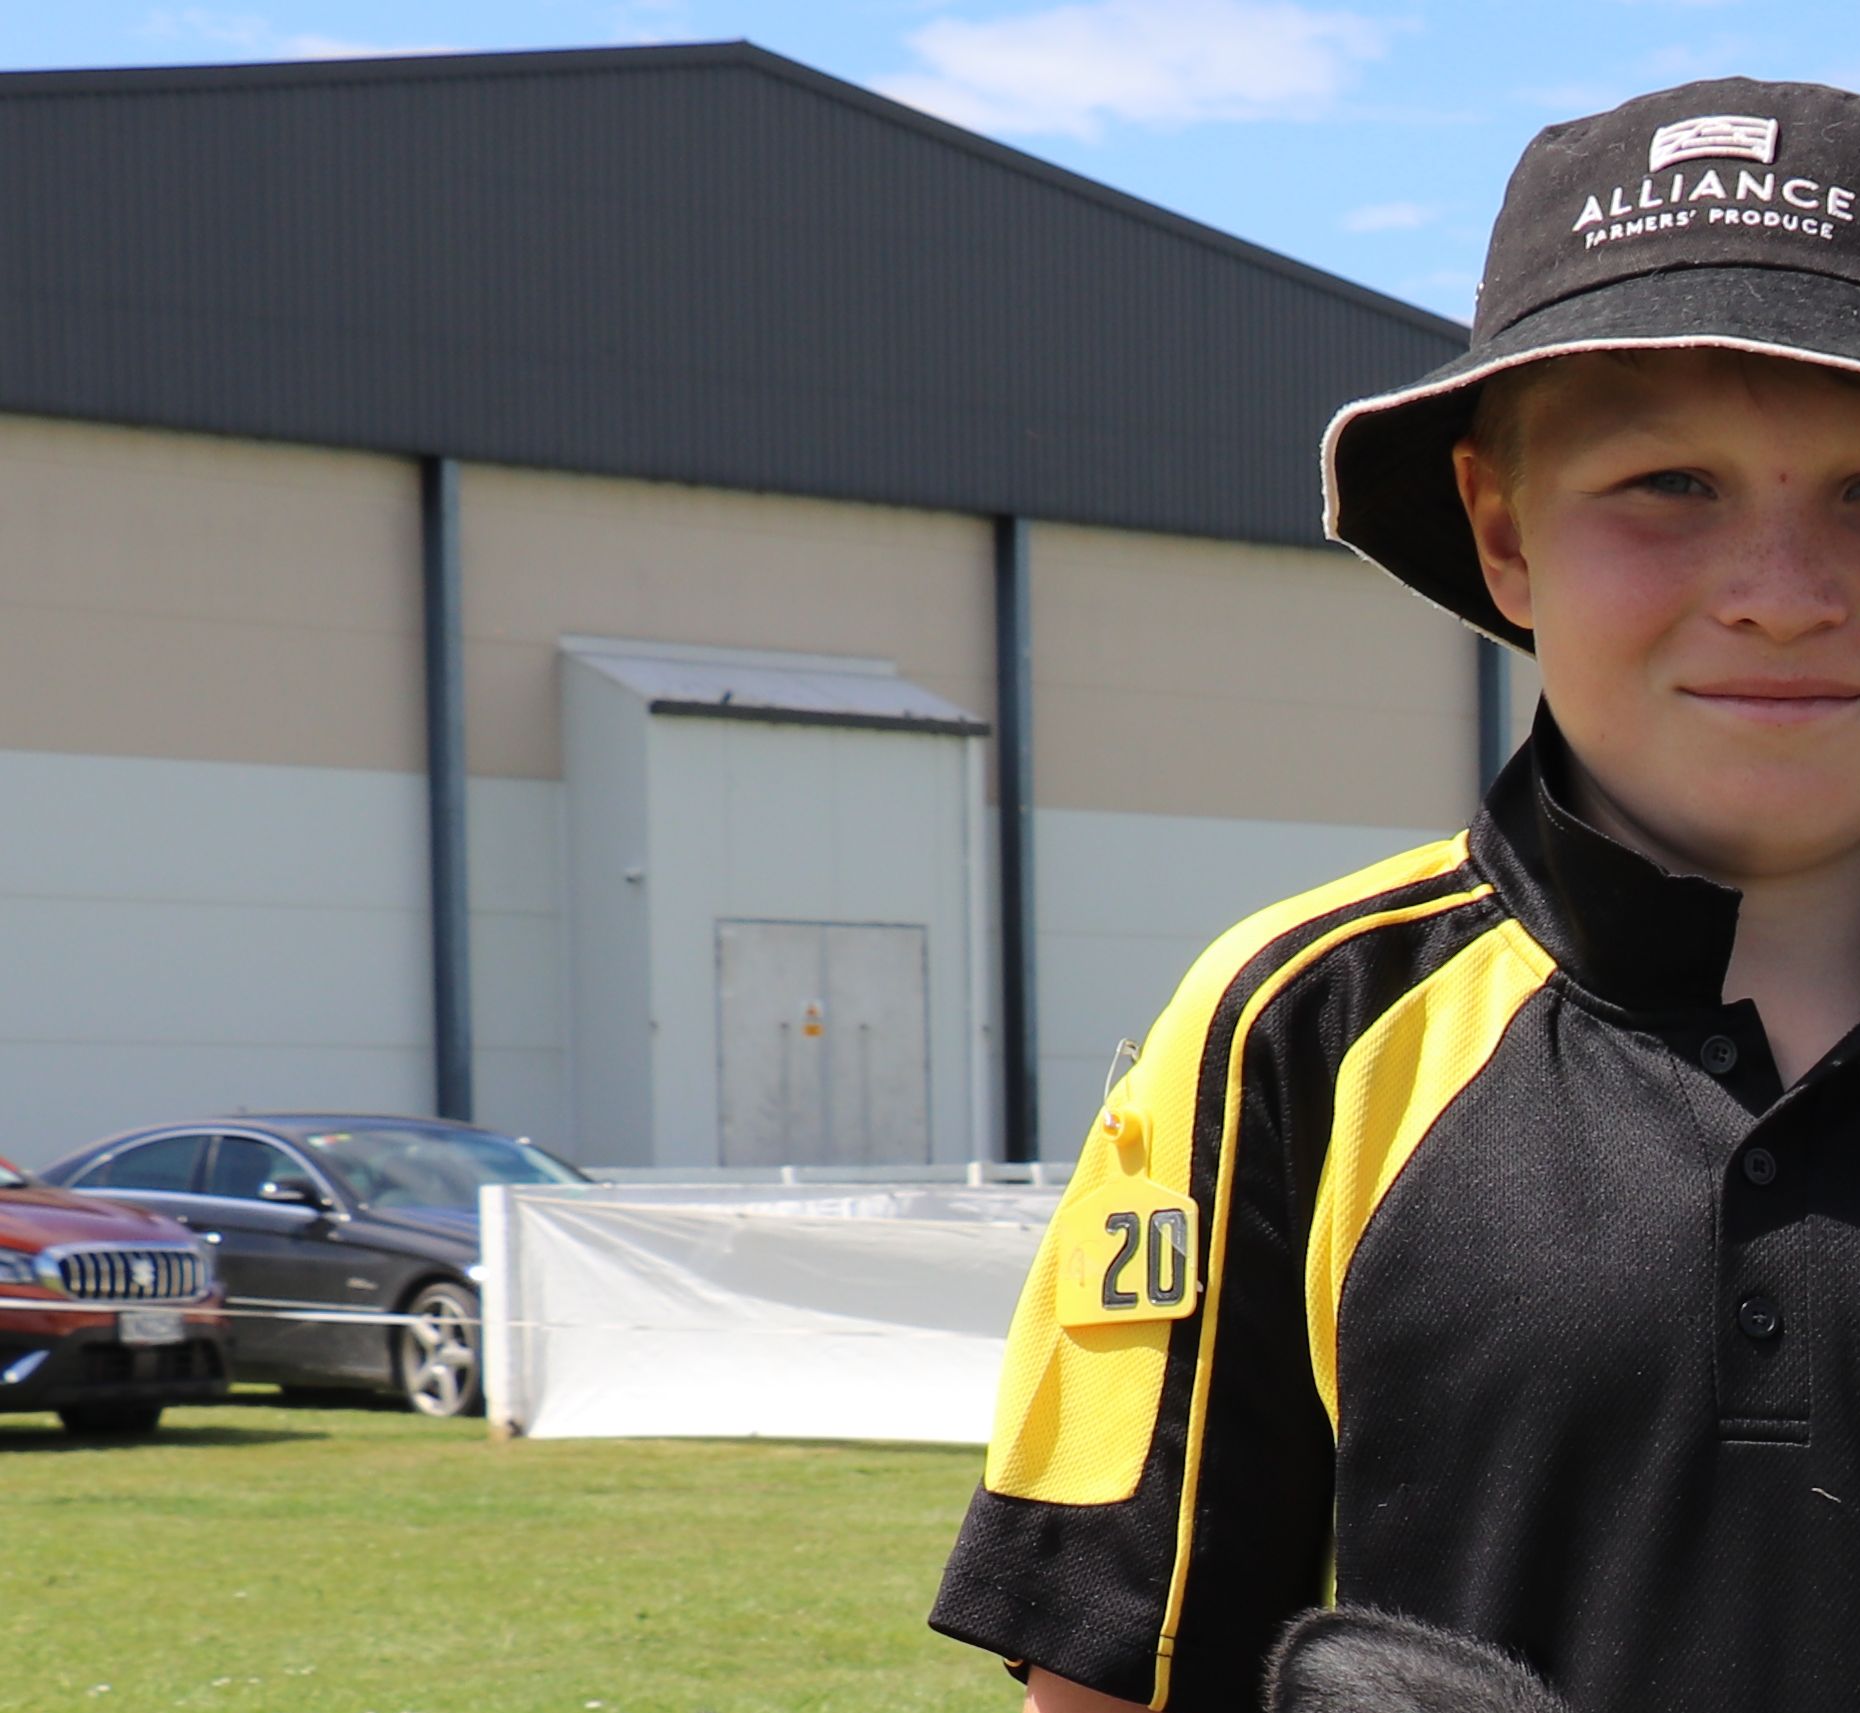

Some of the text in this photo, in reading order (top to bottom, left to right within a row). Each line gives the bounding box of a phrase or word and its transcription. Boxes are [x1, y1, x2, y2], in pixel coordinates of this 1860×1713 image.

[1572, 169, 1856, 232] ALLIANCE
[1585, 207, 1834, 250] FARMERS' PRODUCE
[1102, 1208, 1187, 1311] 20
